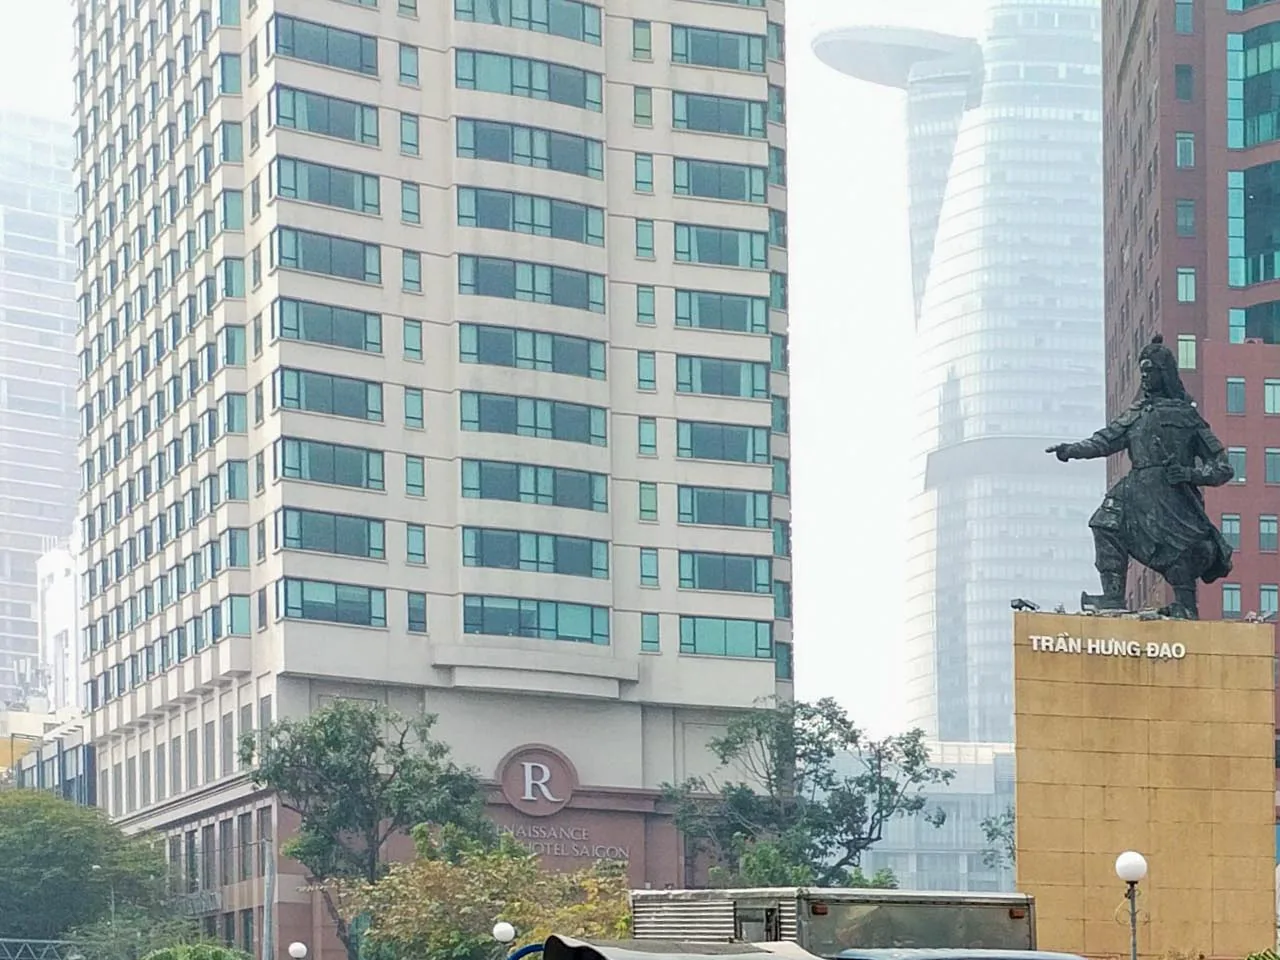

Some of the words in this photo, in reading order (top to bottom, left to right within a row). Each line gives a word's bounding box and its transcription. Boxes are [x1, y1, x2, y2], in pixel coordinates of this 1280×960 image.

[1028, 632, 1082, 653] TRẦN
[1087, 637, 1141, 657] HƯNG
[1146, 642, 1186, 662] ĐẠO
[520, 762, 565, 802] R
[495, 824, 590, 841] ENAISSANCE
[523, 841, 568, 856] HOTEL
[571, 844, 630, 858] SAIGON
